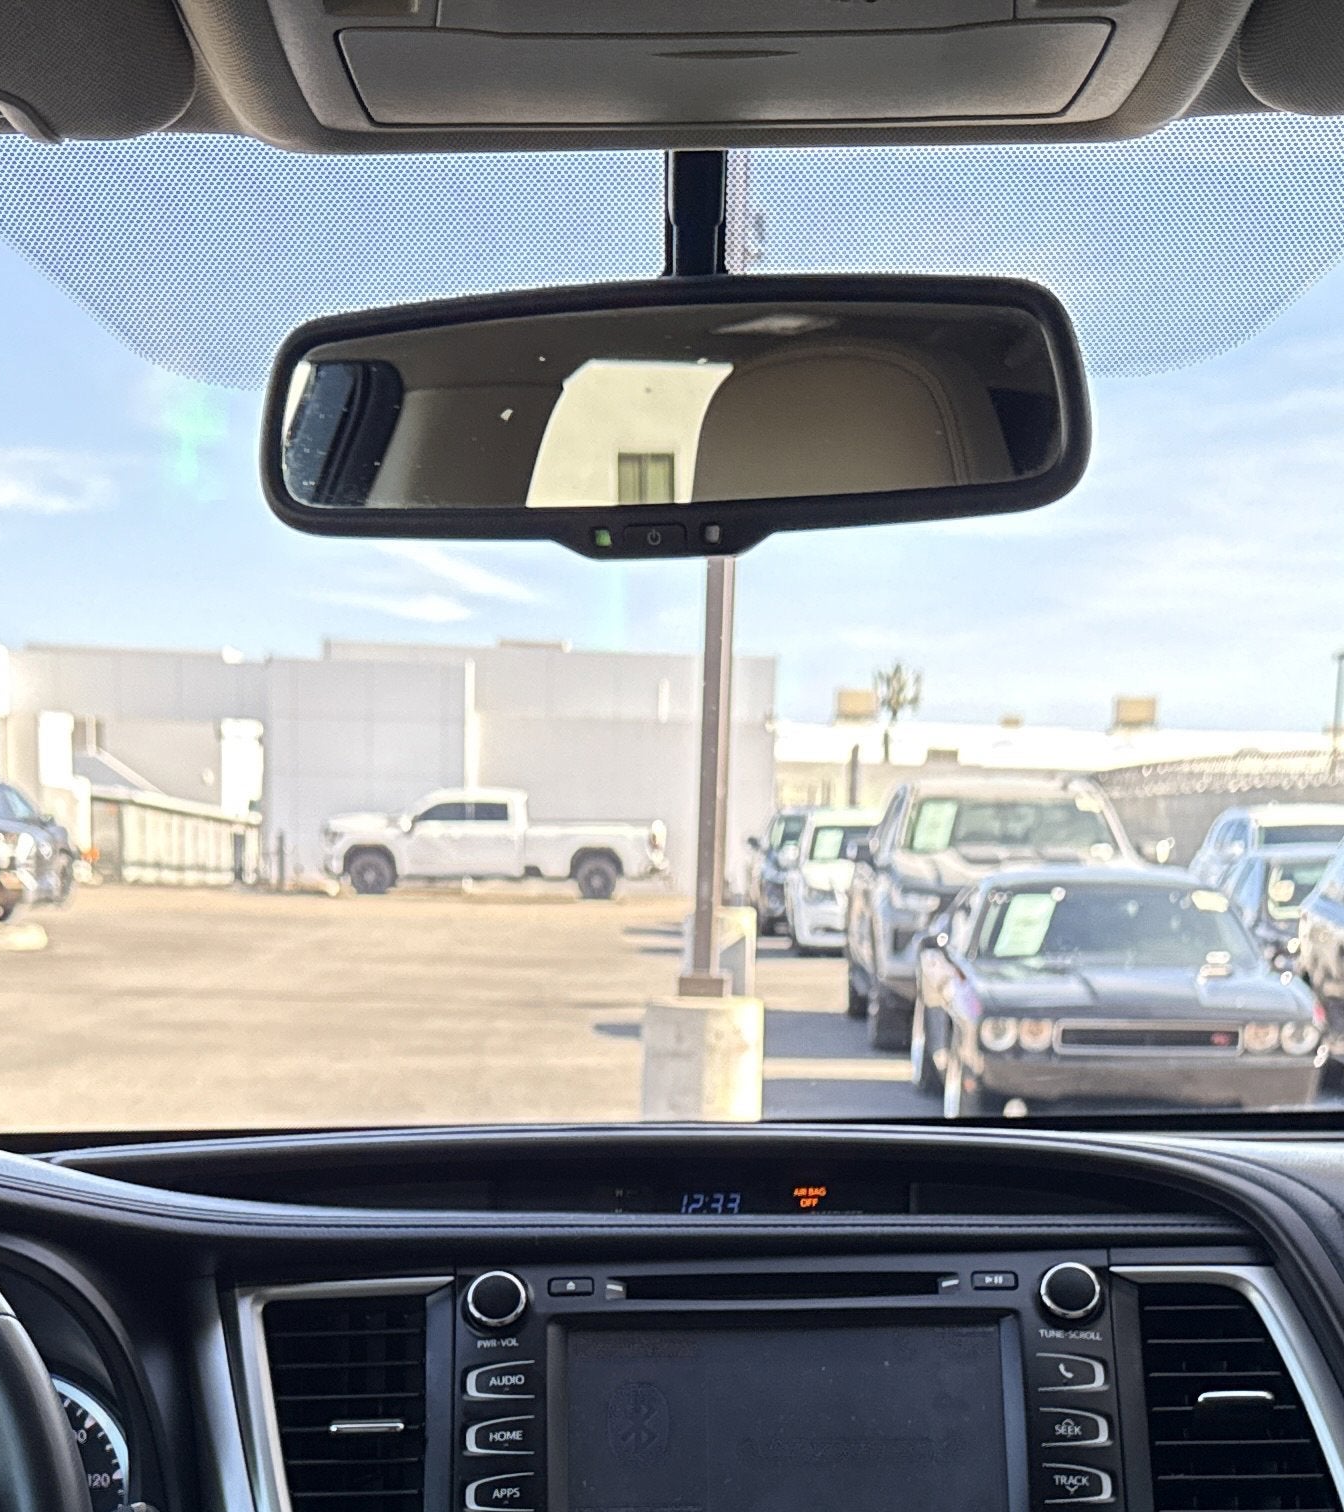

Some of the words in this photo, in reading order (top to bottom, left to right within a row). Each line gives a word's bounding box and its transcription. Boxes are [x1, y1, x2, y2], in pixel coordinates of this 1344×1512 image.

[793, 1187, 807, 1198] AIR
[808, 1186, 827, 1197] BAG
[680, 1193, 741, 1214] 12:33
[800, 1198, 819, 1208] OFF
[488, 1375, 525, 1386] AUDIO
[1054, 1424, 1082, 1435] SEEK
[488, 1431, 524, 1441] HOME
[88, 1473, 111, 1488] 120
[1053, 1475, 1090, 1486] TRACK
[492, 1488, 520, 1499] APPS
